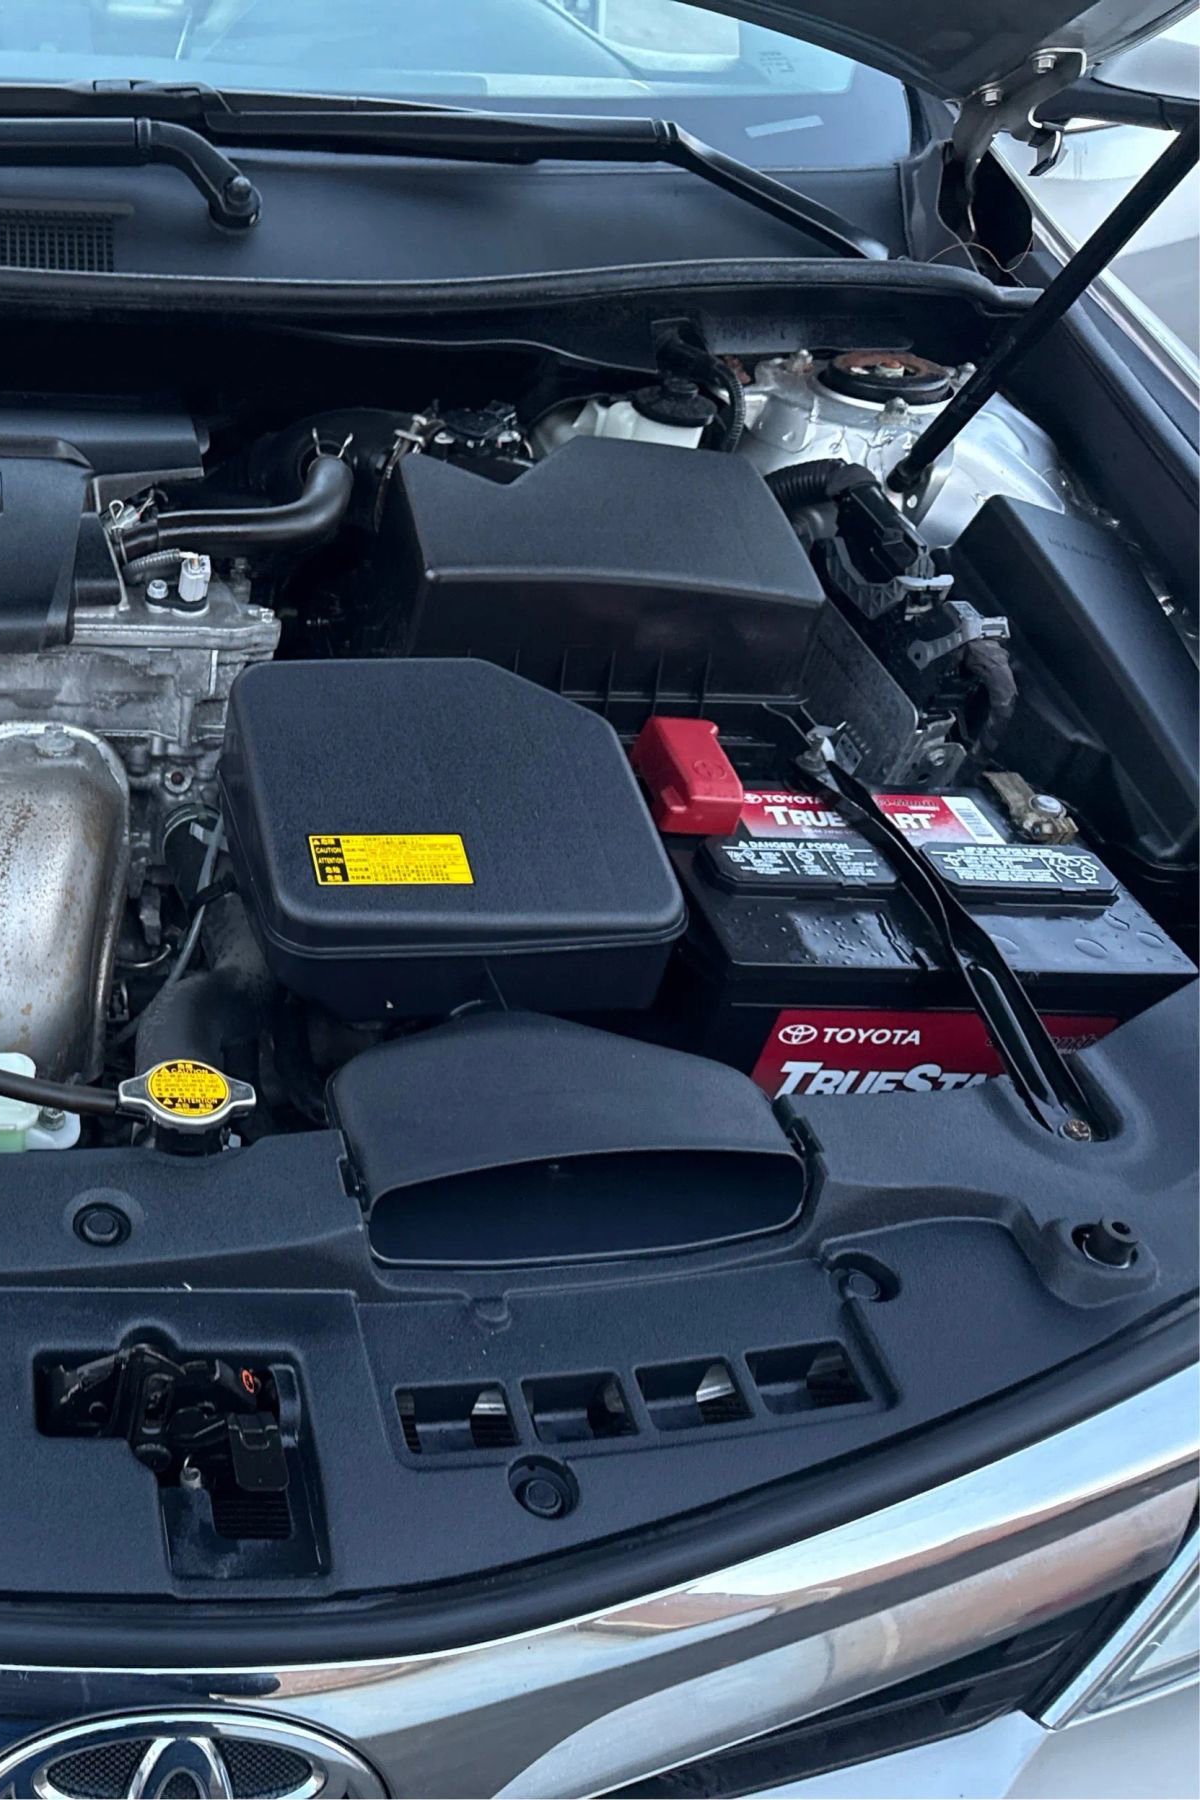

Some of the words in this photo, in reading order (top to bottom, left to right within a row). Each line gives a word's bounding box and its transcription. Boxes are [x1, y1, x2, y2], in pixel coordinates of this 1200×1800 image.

[749, 841, 796, 849] DANGER
[806, 842, 849, 850] POISON
[315, 846, 343, 854] CAUTION
[822, 1027, 921, 1046] TOYOTA
[171, 1067, 209, 1075] CAUTION
[774, 1060, 1008, 1100] TRUEST
[177, 1097, 218, 1105] ATTENTION
